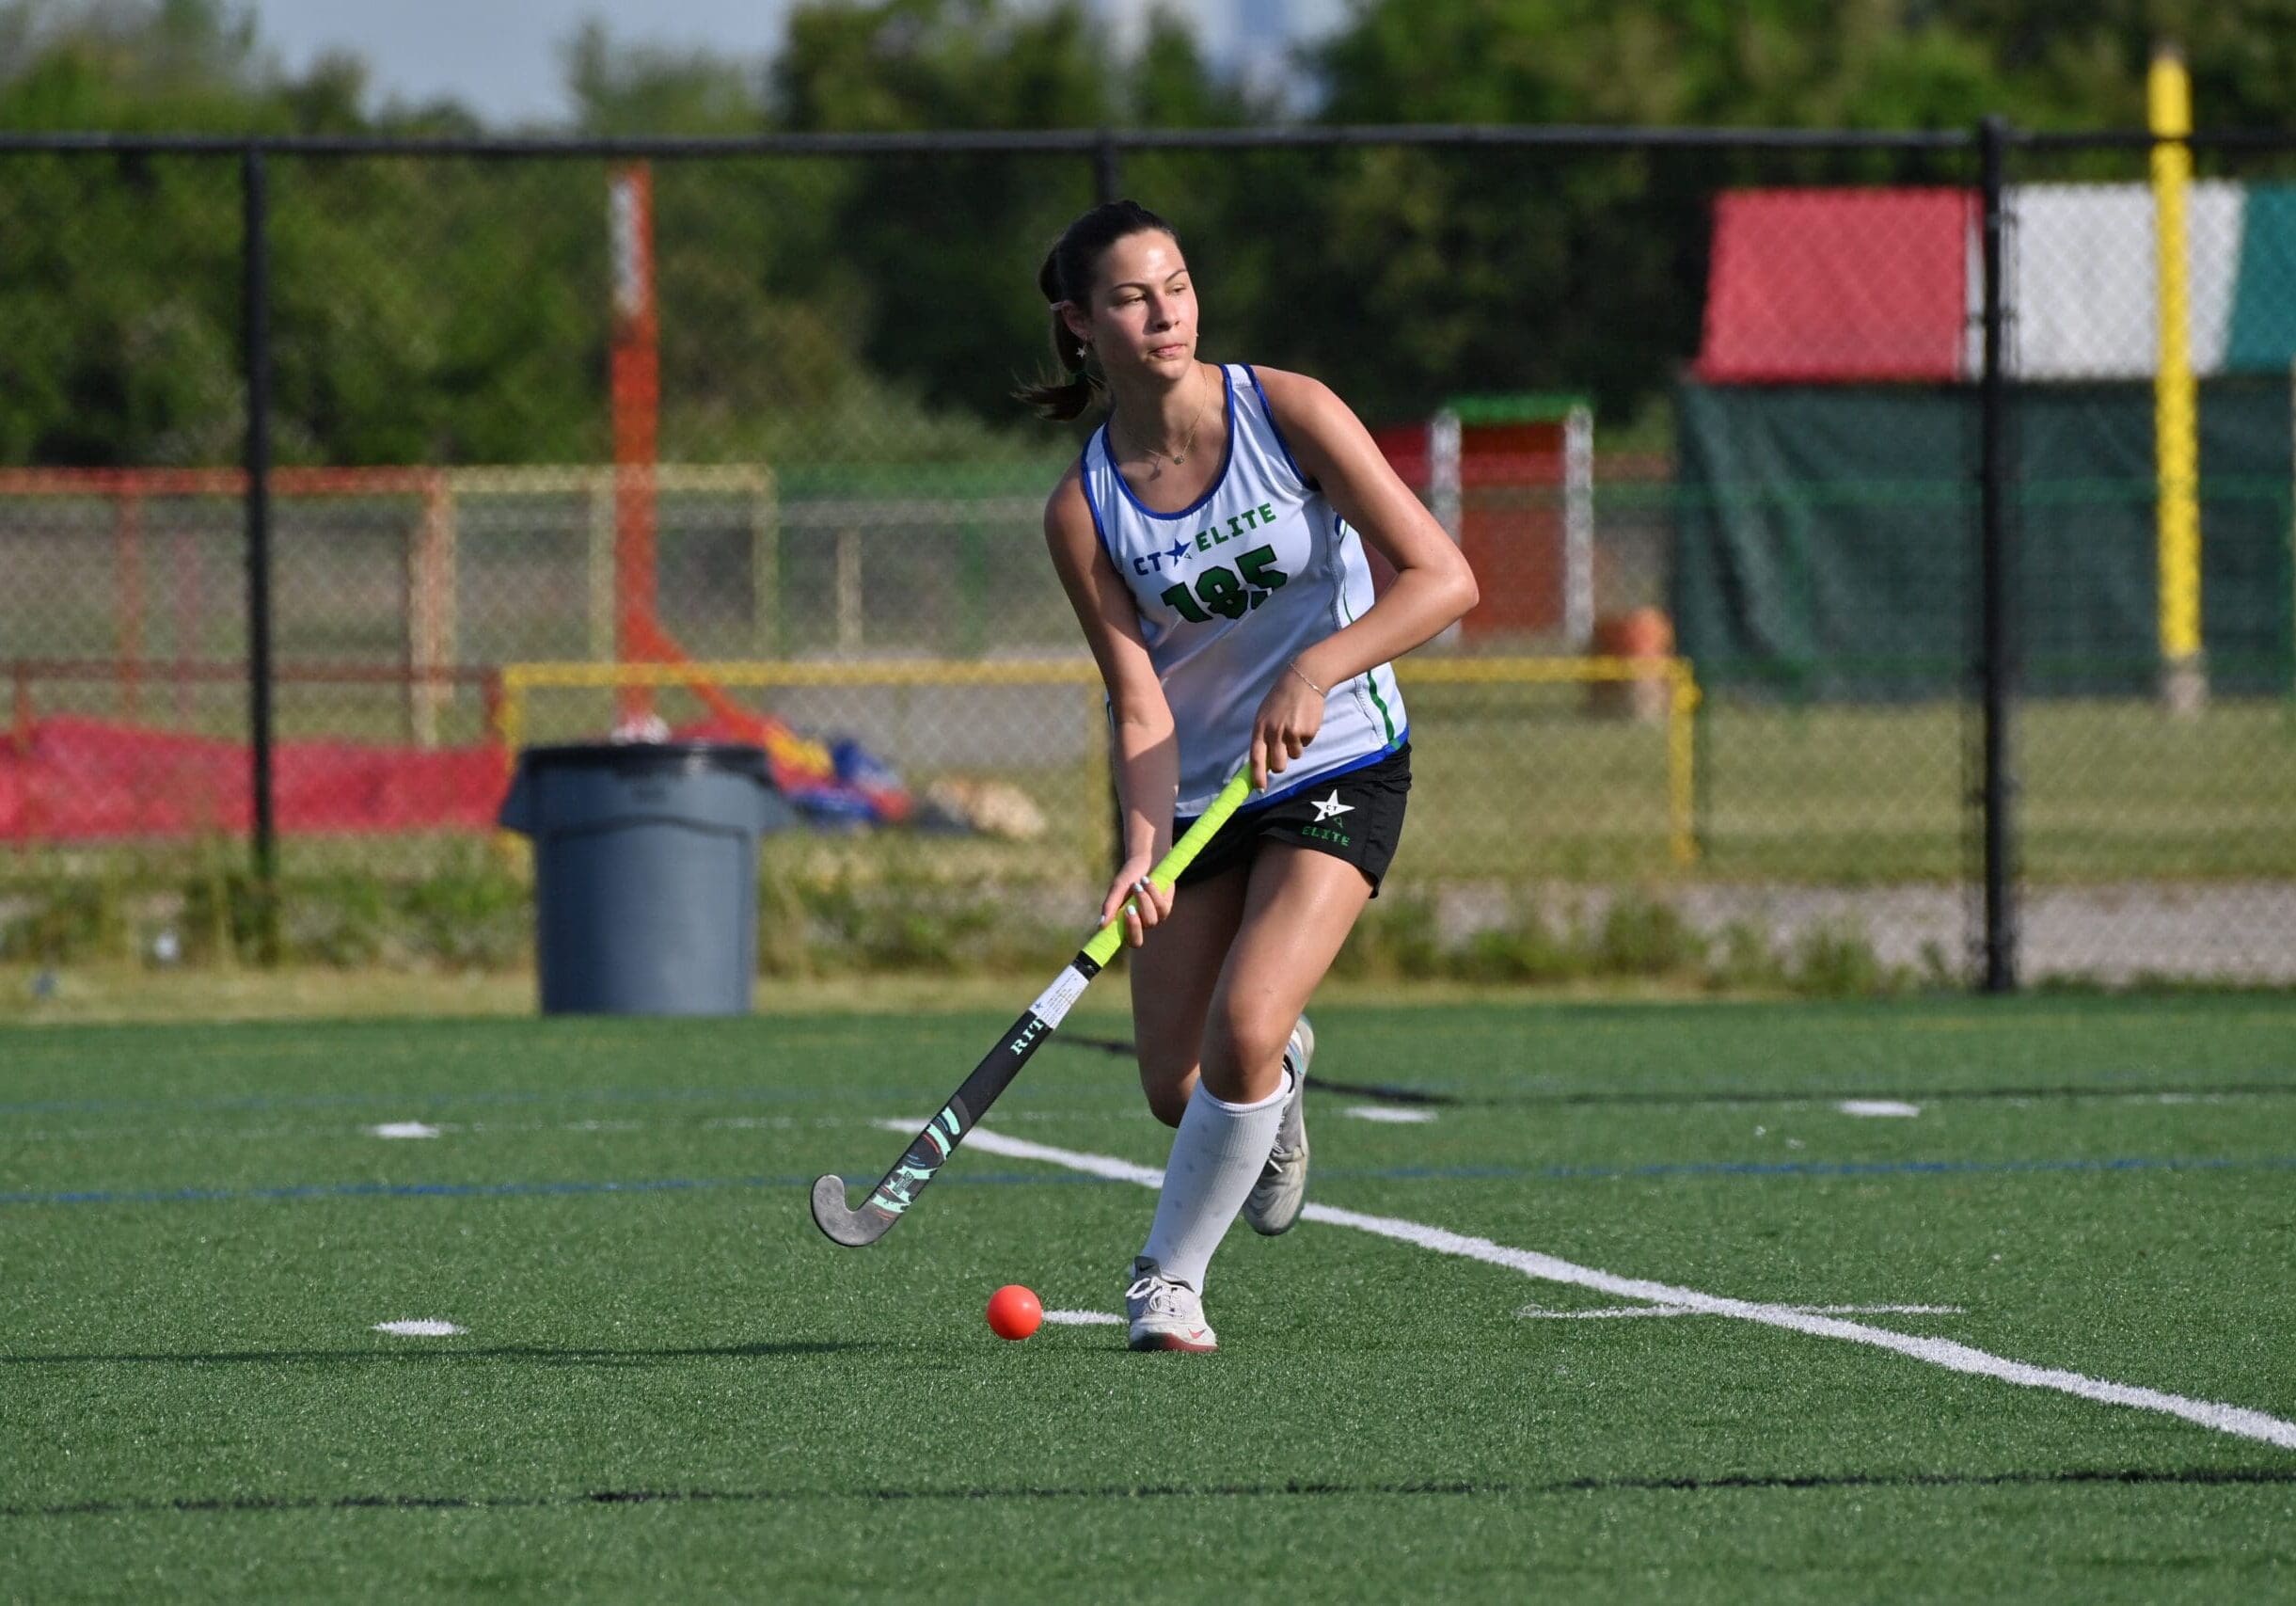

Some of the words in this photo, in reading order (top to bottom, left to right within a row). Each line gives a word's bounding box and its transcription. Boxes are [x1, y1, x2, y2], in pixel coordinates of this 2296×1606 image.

[1133, 552, 1162, 577] CT
[1195, 502, 1276, 552] ELITE
[1161, 544, 1289, 623] 185
[1302, 826, 1351, 847] ELITE
